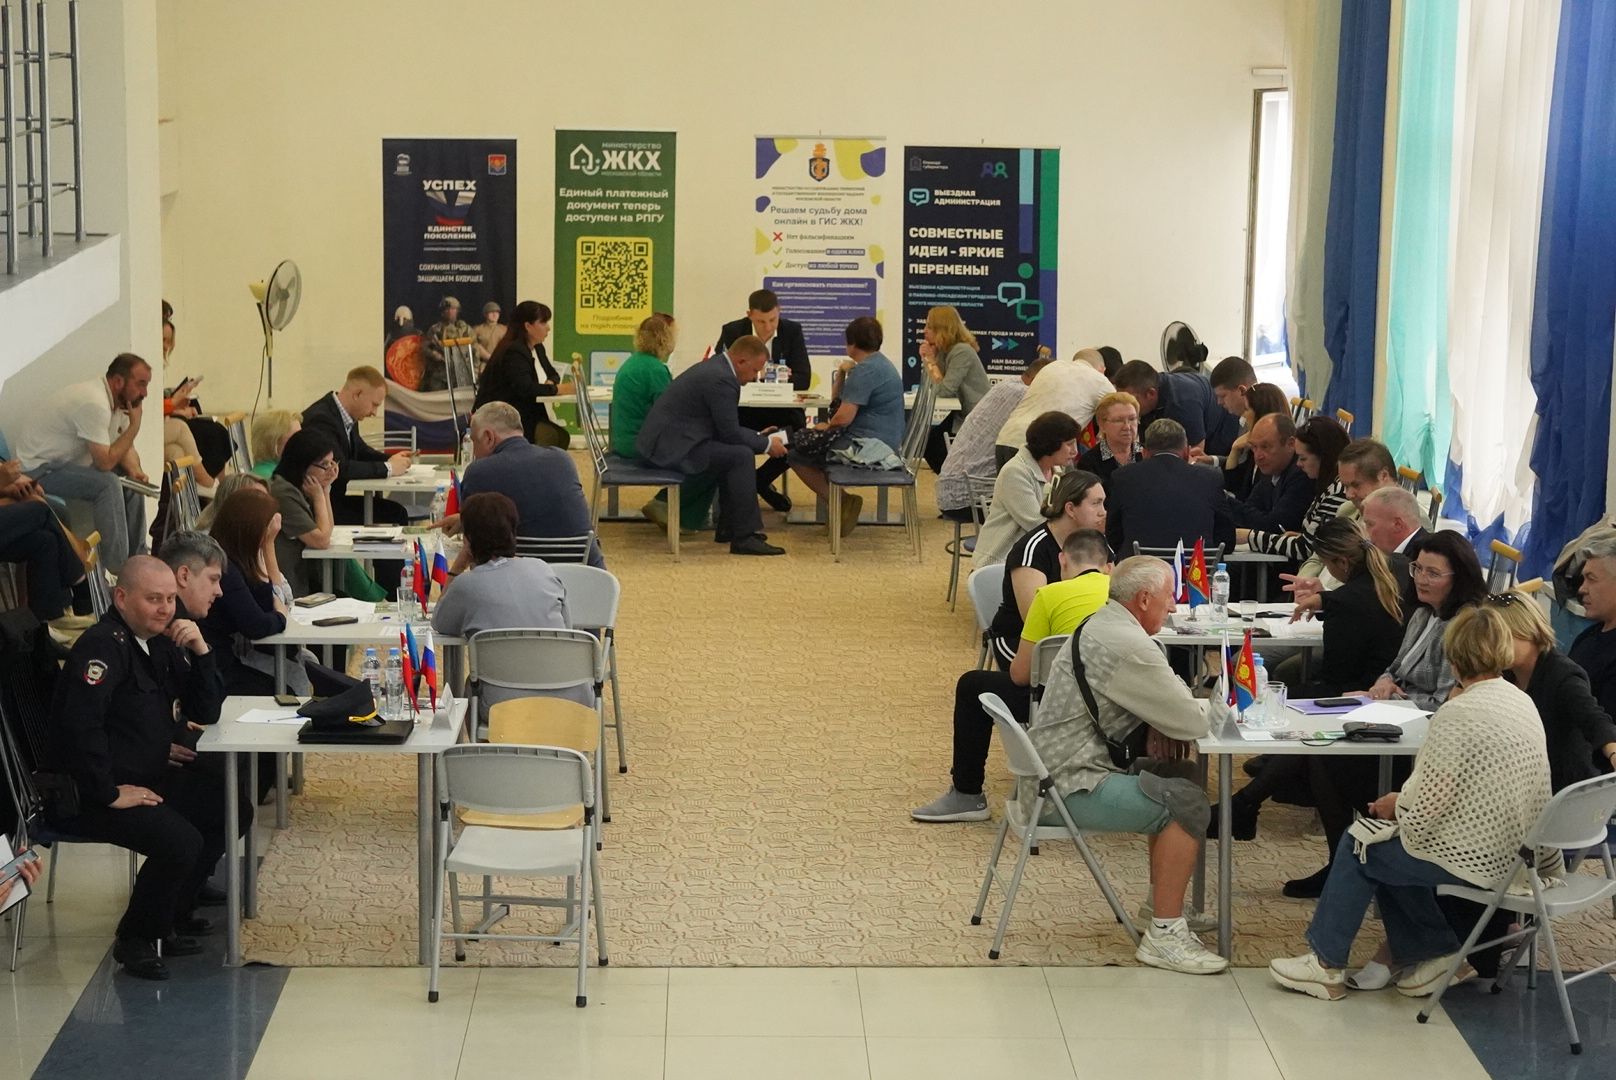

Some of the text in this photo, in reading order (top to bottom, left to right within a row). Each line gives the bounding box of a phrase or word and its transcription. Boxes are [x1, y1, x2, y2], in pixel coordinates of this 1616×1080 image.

[601, 150, 661, 170] ЖКХ
[422, 179, 476, 191] УСПЕХ
[559, 187, 669, 199] Единый платежный
[934, 189, 976, 197] ВЫЕЗДНАЯ
[566, 202, 661, 212] документ теперь
[934, 198, 1001, 206] АДМИНИСТРАЦИЯ
[770, 206, 807, 215] Решаем
[809, 207, 841, 216] судьбу
[565, 213, 665, 223] доступен на РПГУ
[774, 217, 808, 225] онлайн
[840, 218, 863, 226] ЖКХ!
[423, 232, 477, 240] ПОКОЛЕНИЙ
[909, 227, 1004, 240] СОВМЕСТНЫЕ
[909, 245, 948, 258] ИДЕИ
[958, 246, 1004, 258] ЯРКИЕ
[419, 263, 481, 271] СОХРАНЯЯ ПРОШЛОЕ
[909, 263, 989, 276] ПЕРЕМЕНЫ!
[417, 275, 454, 283] ЗАЩИЩАЕМ
